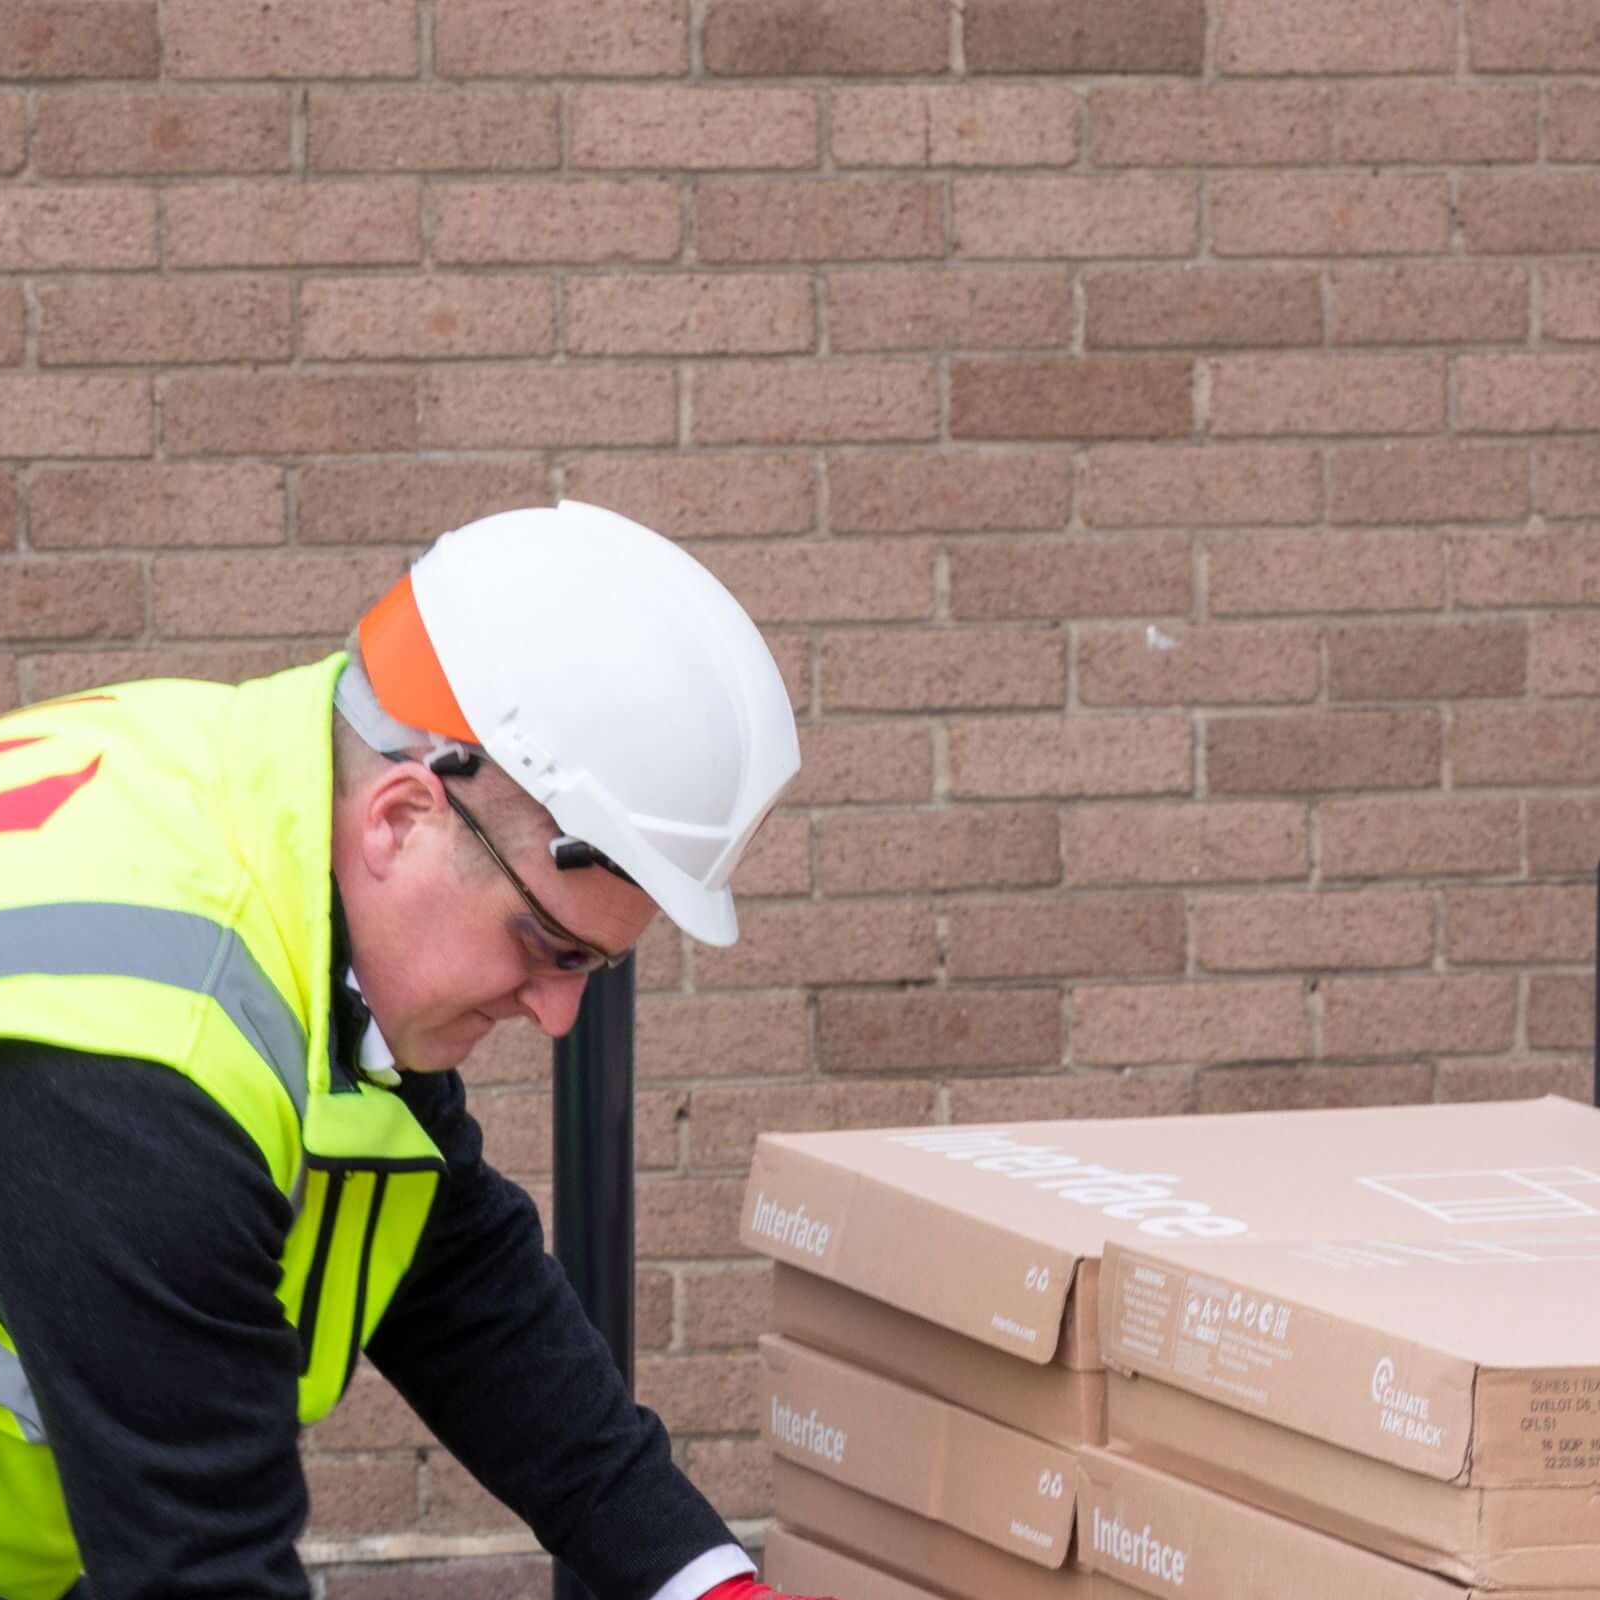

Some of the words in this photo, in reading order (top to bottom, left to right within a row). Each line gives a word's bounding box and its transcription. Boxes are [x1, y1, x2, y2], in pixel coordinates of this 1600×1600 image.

[880, 1130, 1248, 1239] Interface
[752, 1191, 832, 1256] Interface
[772, 1394, 846, 1464] Interface
[1381, 1387, 1429, 1420] CLIMATE
[1403, 1419, 1442, 1448] BACK
[1093, 1504, 1185, 1585] Interface
